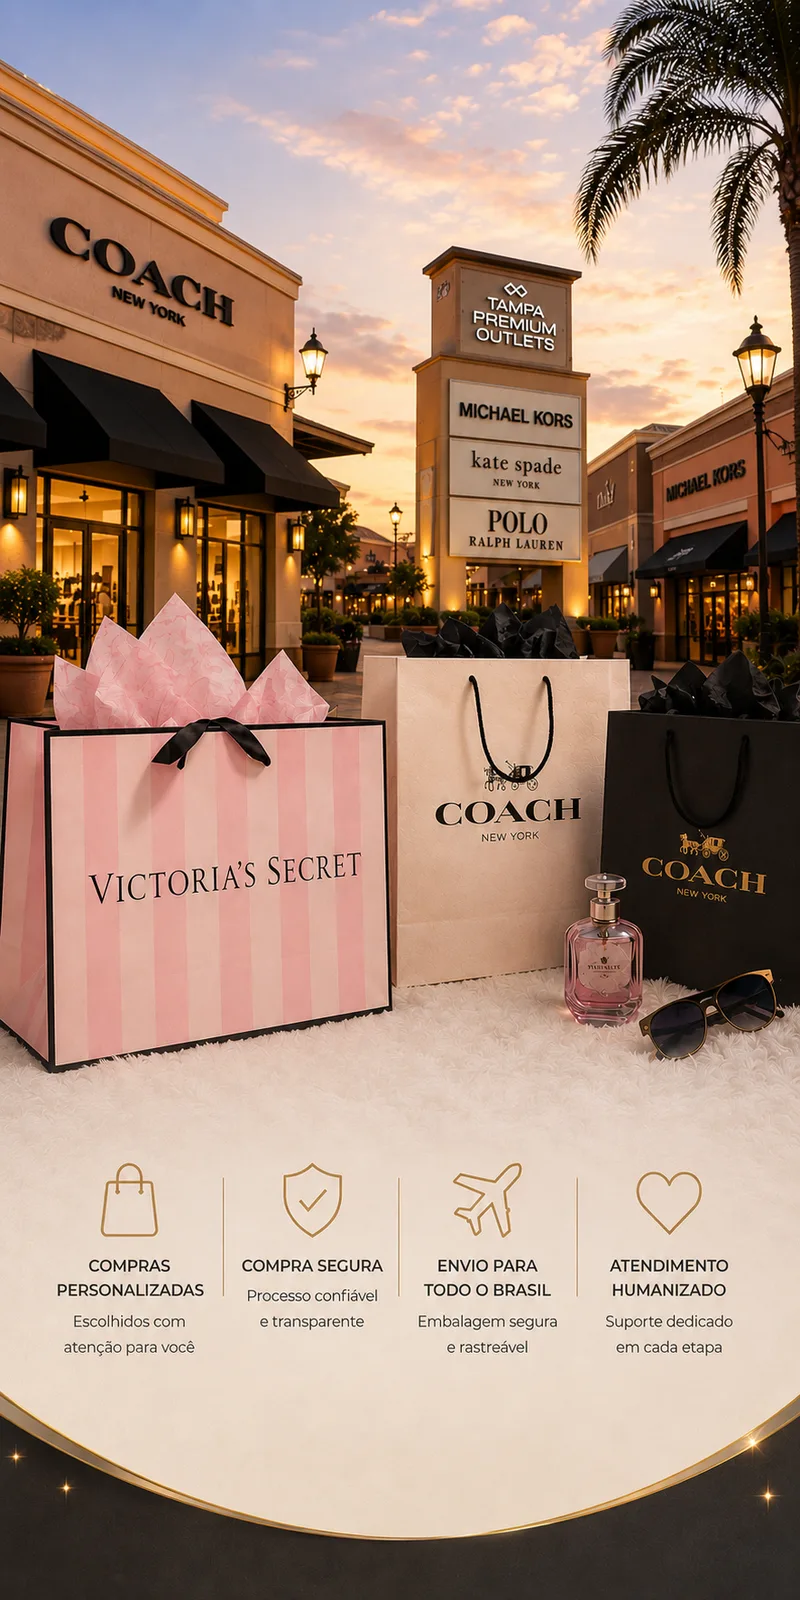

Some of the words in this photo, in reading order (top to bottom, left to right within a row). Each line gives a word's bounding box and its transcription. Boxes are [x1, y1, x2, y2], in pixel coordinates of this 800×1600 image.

[50, 217, 235, 326] COACH
[112, 286, 145, 309] NEW
[149, 301, 186, 326] YORK
[487, 296, 545, 319] TAMPA
[473, 310, 556, 337] PREMIUM
[476, 327, 555, 352] OUTLETS
[459, 402, 529, 424] MICHAEL
[534, 410, 573, 429] KORS
[471, 451, 508, 470] kate
[514, 456, 562, 476] spade
[493, 479, 514, 487] NEW
[517, 480, 540, 490] YORK
[666, 472, 711, 502] MICHAEL
[713, 459, 746, 485] KORS
[488, 510, 548, 535] POLO
[469, 536, 511, 549] RALPH
[516, 538, 563, 551] LAUREN
[435, 797, 581, 826] COACH
[481, 833, 507, 842] NEW
[510, 831, 539, 841] YORK
[89, 861, 257, 904] VICTORIA'S
[268, 852, 362, 886] SECRET
[642, 856, 766, 895] COACH
[677, 888, 698, 897] NEW
[701, 892, 727, 903] YORK
